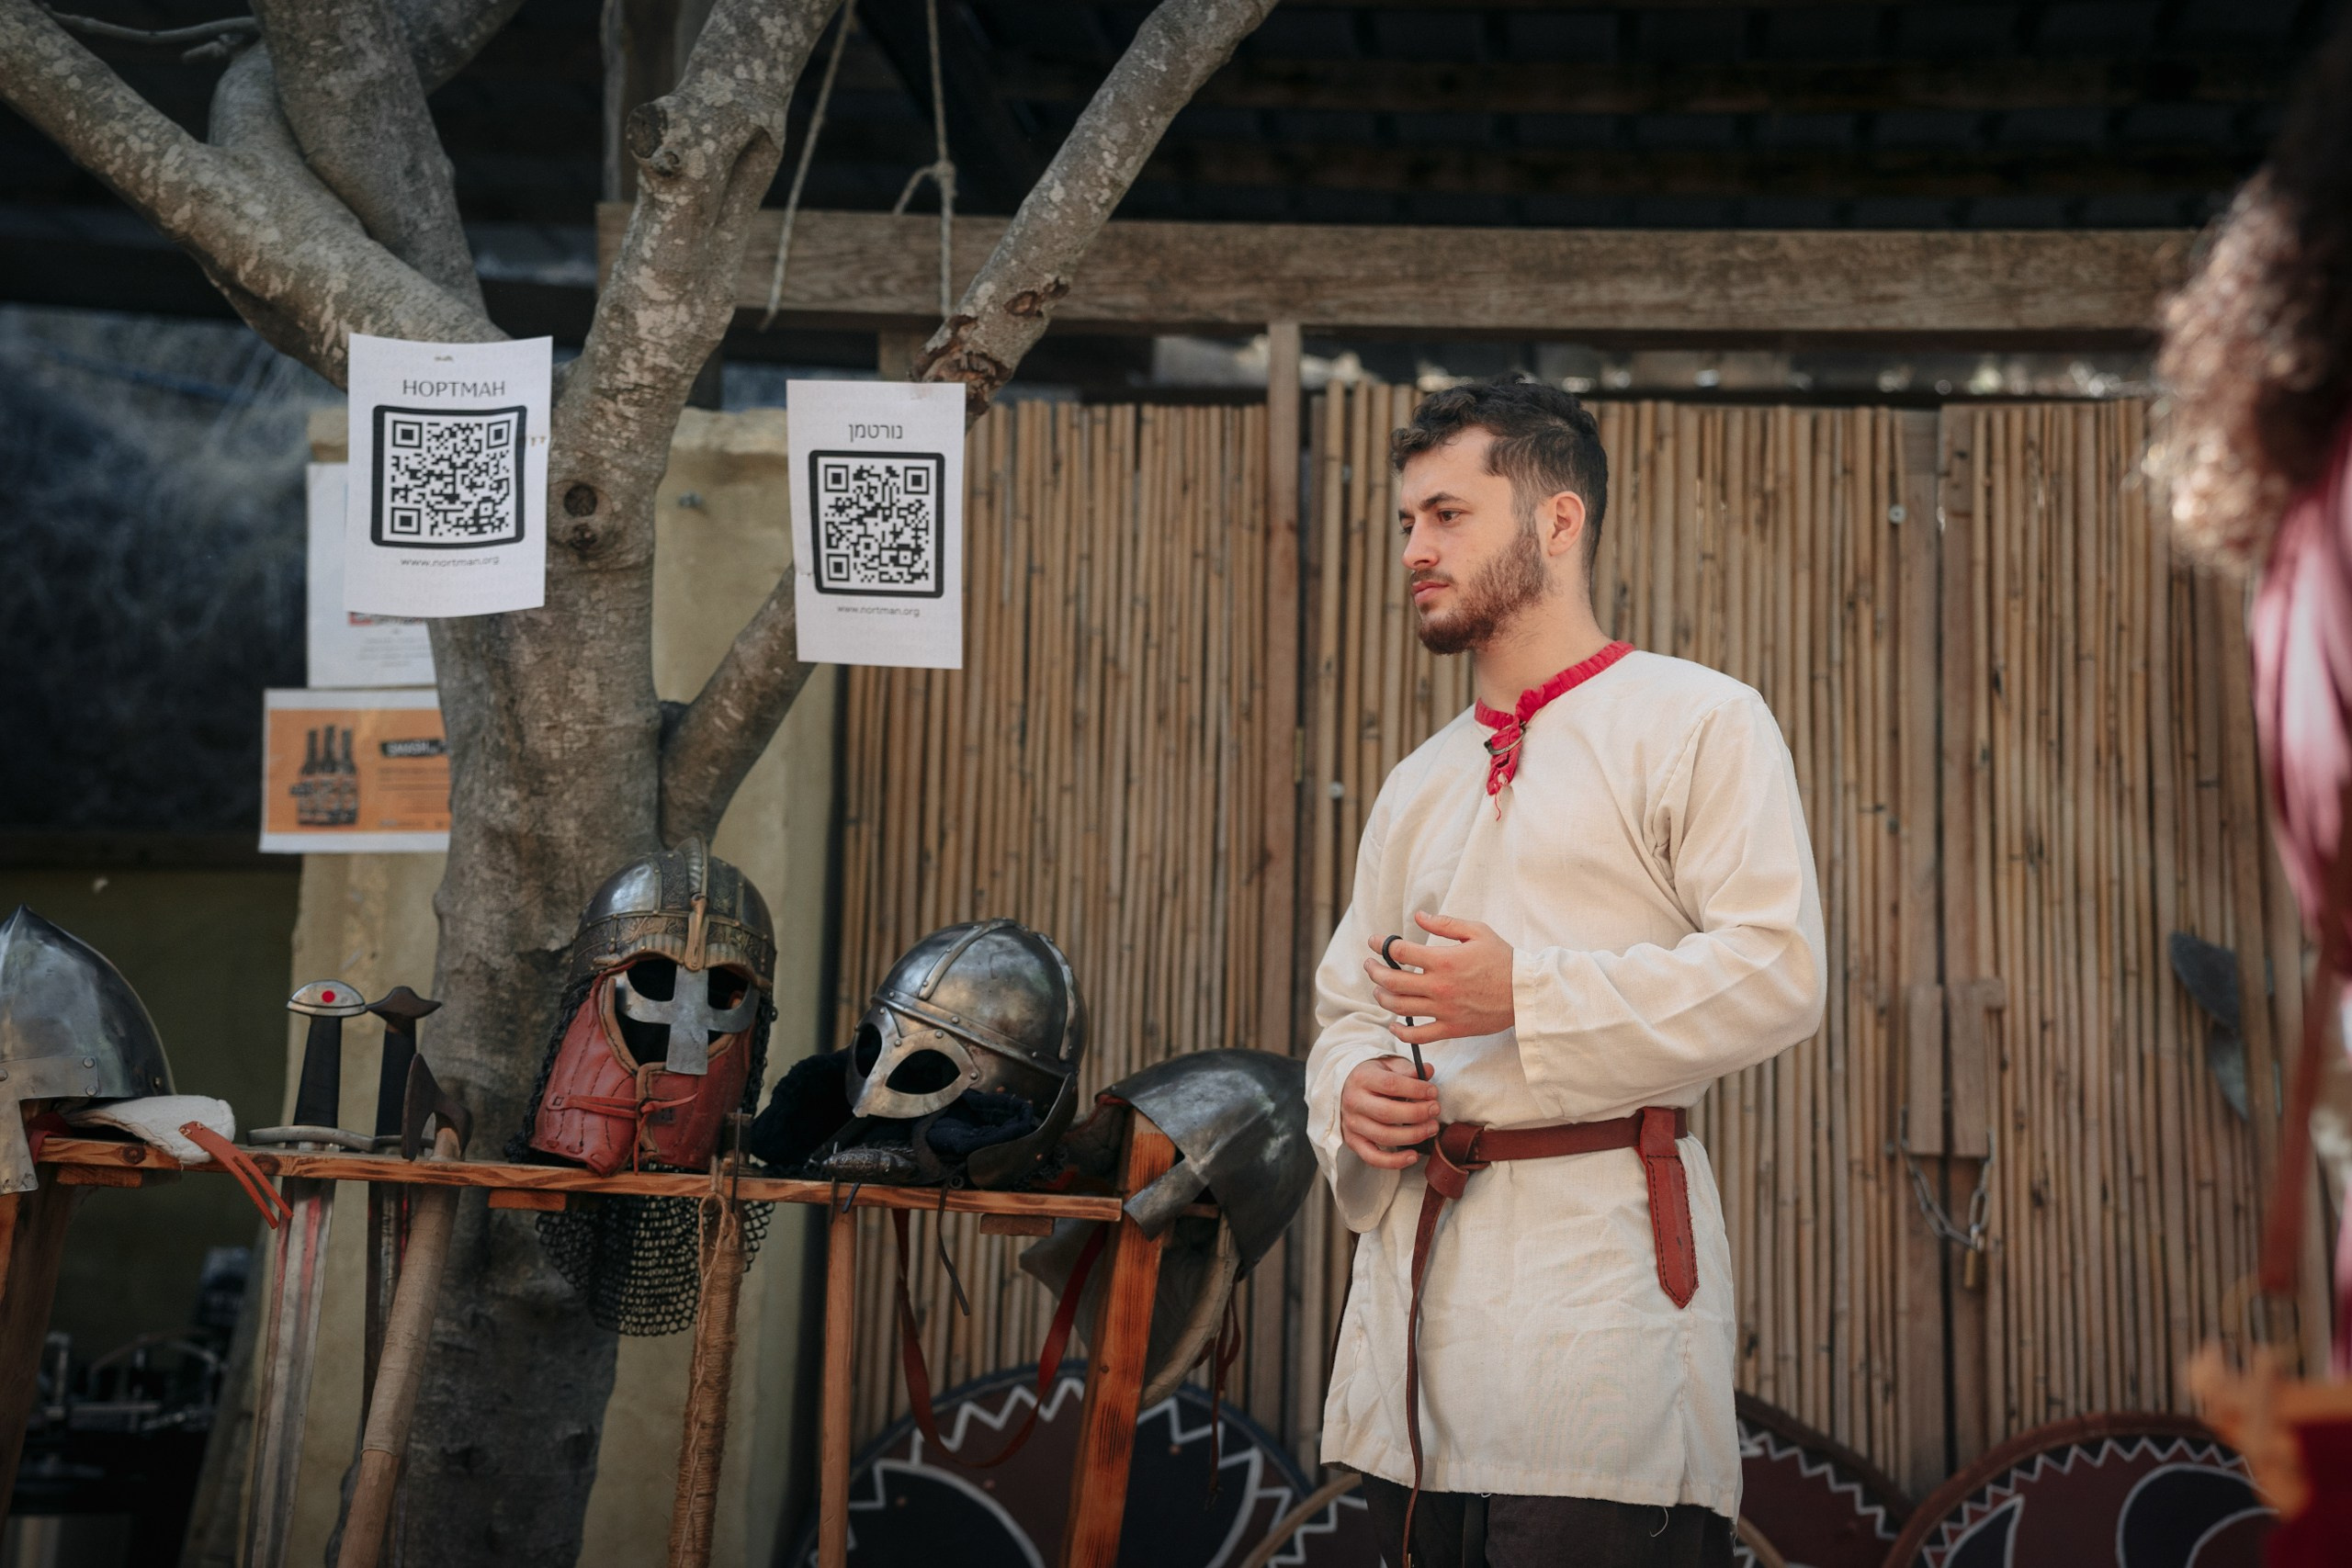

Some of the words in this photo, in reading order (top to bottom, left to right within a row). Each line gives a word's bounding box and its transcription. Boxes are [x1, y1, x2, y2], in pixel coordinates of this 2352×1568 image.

[402, 378, 505, 398] НОРТМАН
[848, 423, 903, 443] נורטמן
[400, 556, 500, 568] www.nortman.org
[837, 605, 921, 618] www.nortman.org
